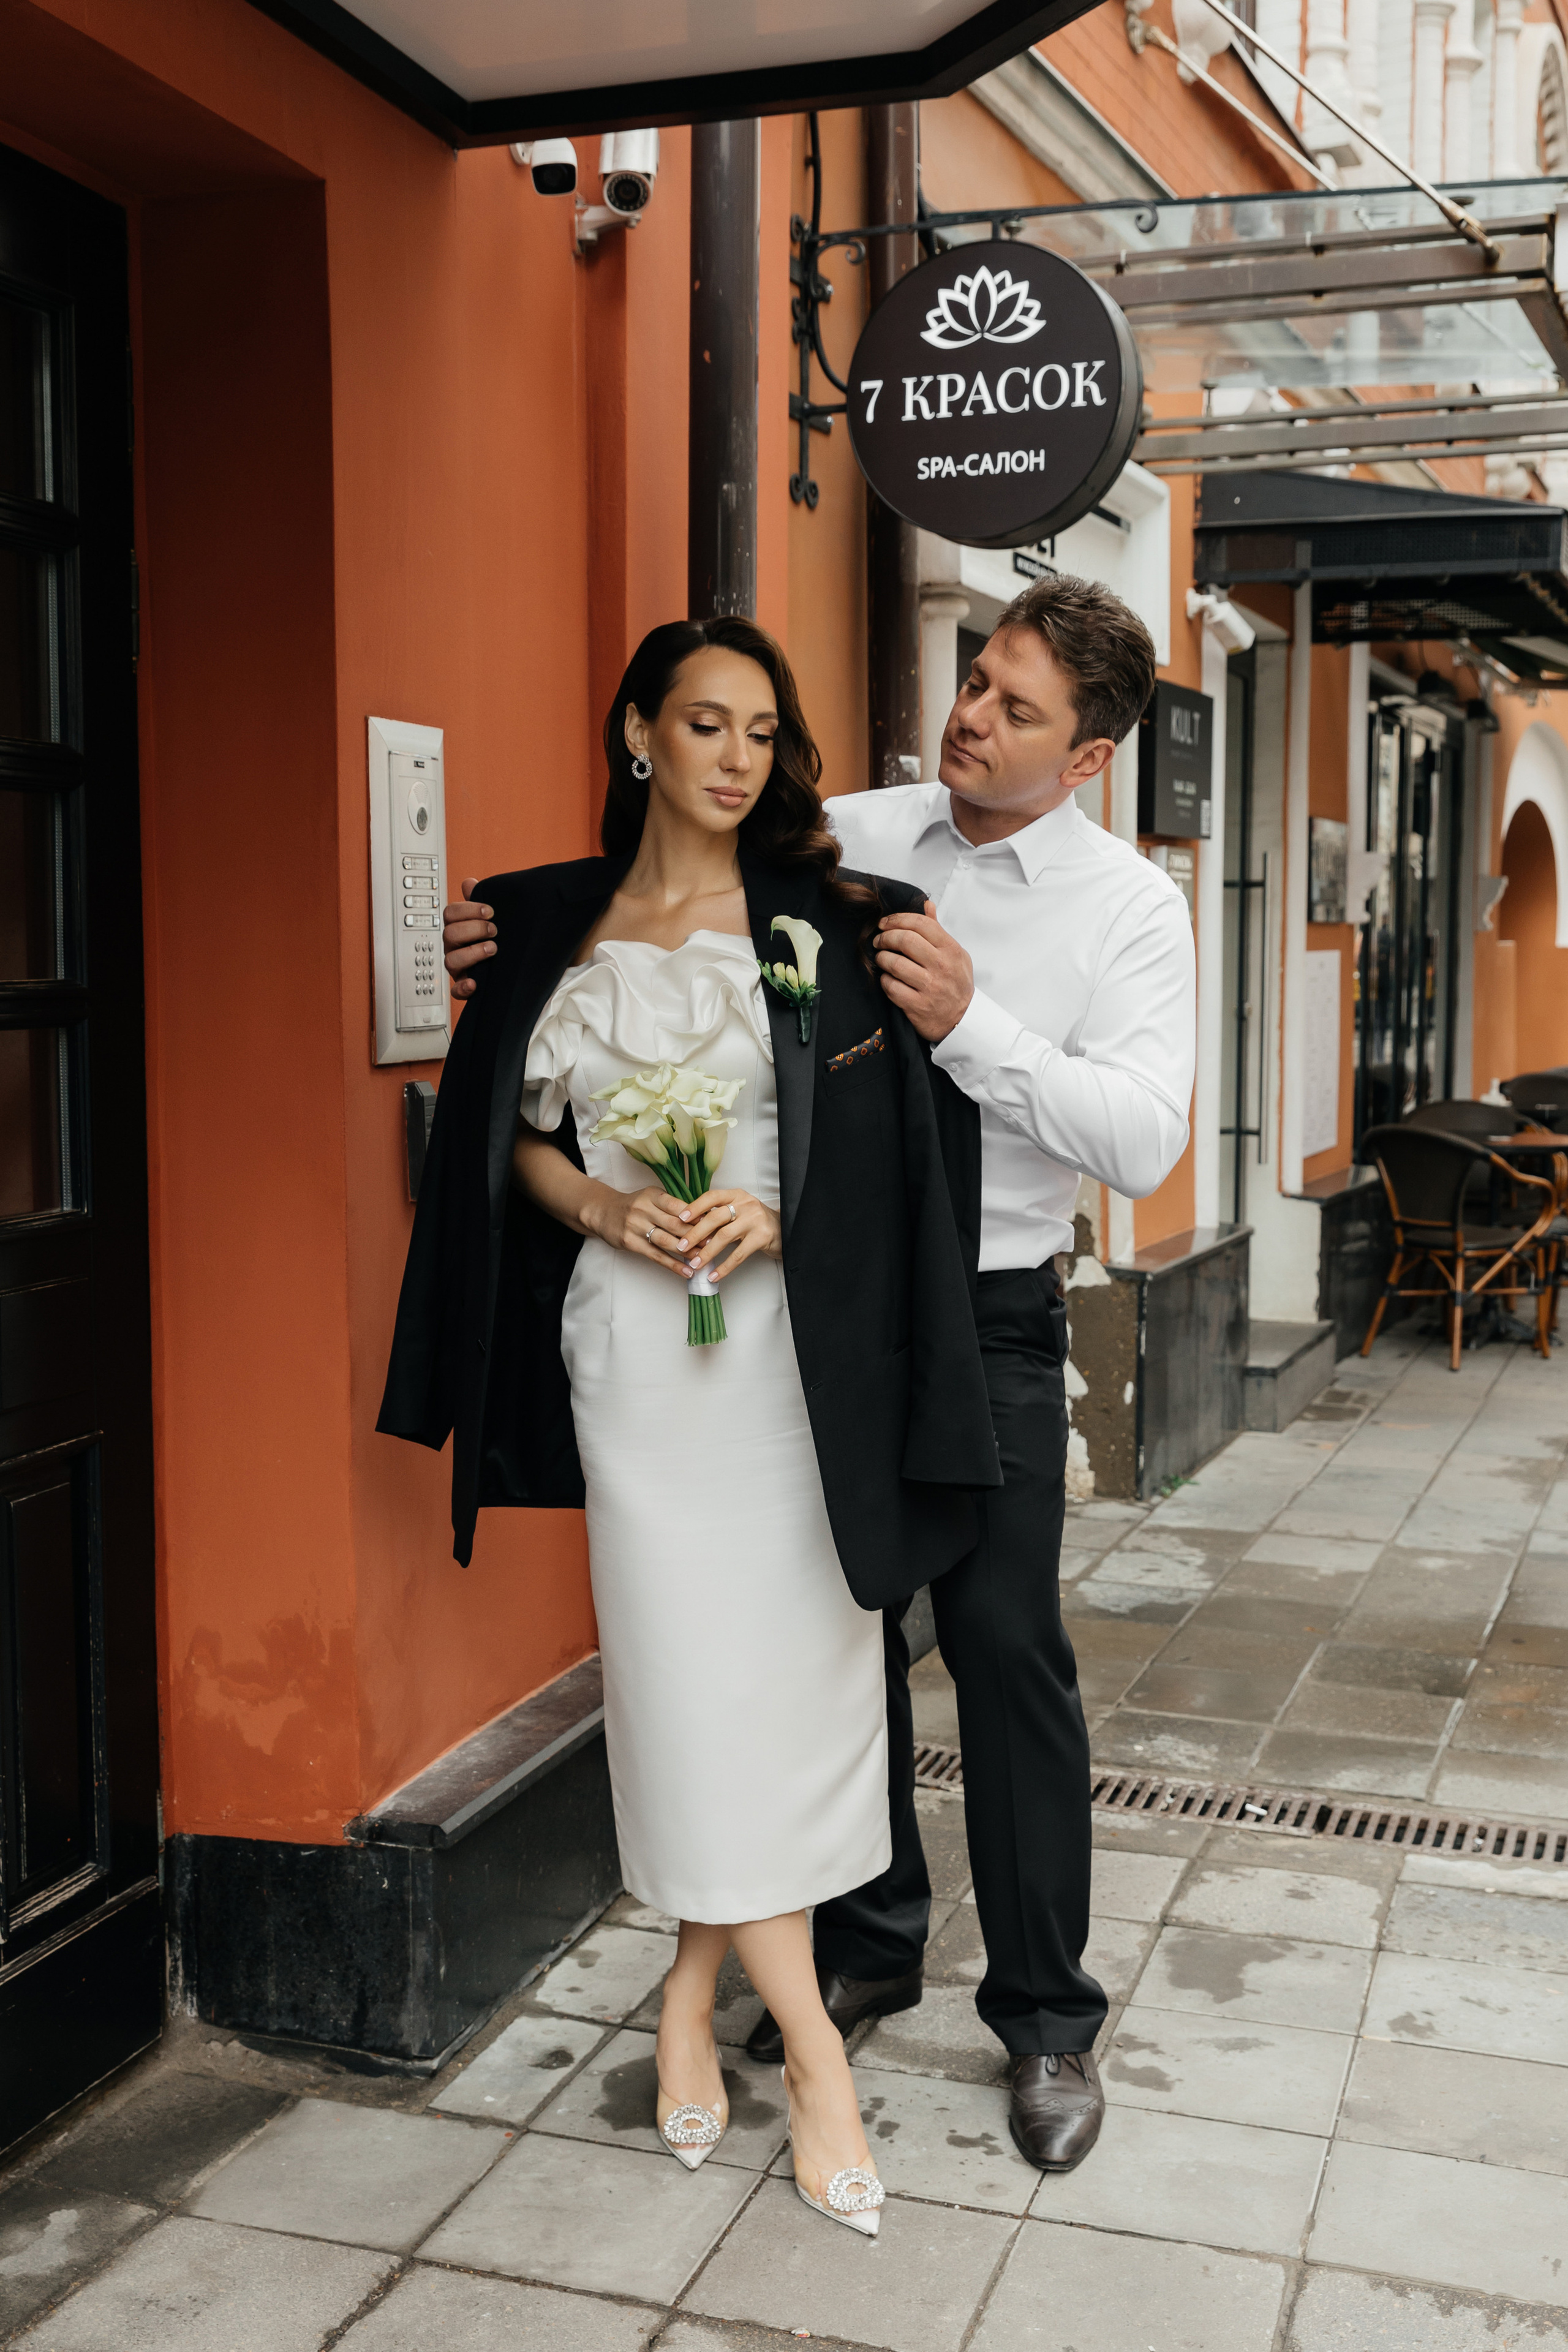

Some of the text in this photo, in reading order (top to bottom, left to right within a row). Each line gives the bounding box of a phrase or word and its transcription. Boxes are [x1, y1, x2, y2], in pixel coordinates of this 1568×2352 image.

[860, 360, 1107, 424] 7 КРАСОК
[917, 448, 1045, 480] SPA-САЛОН
